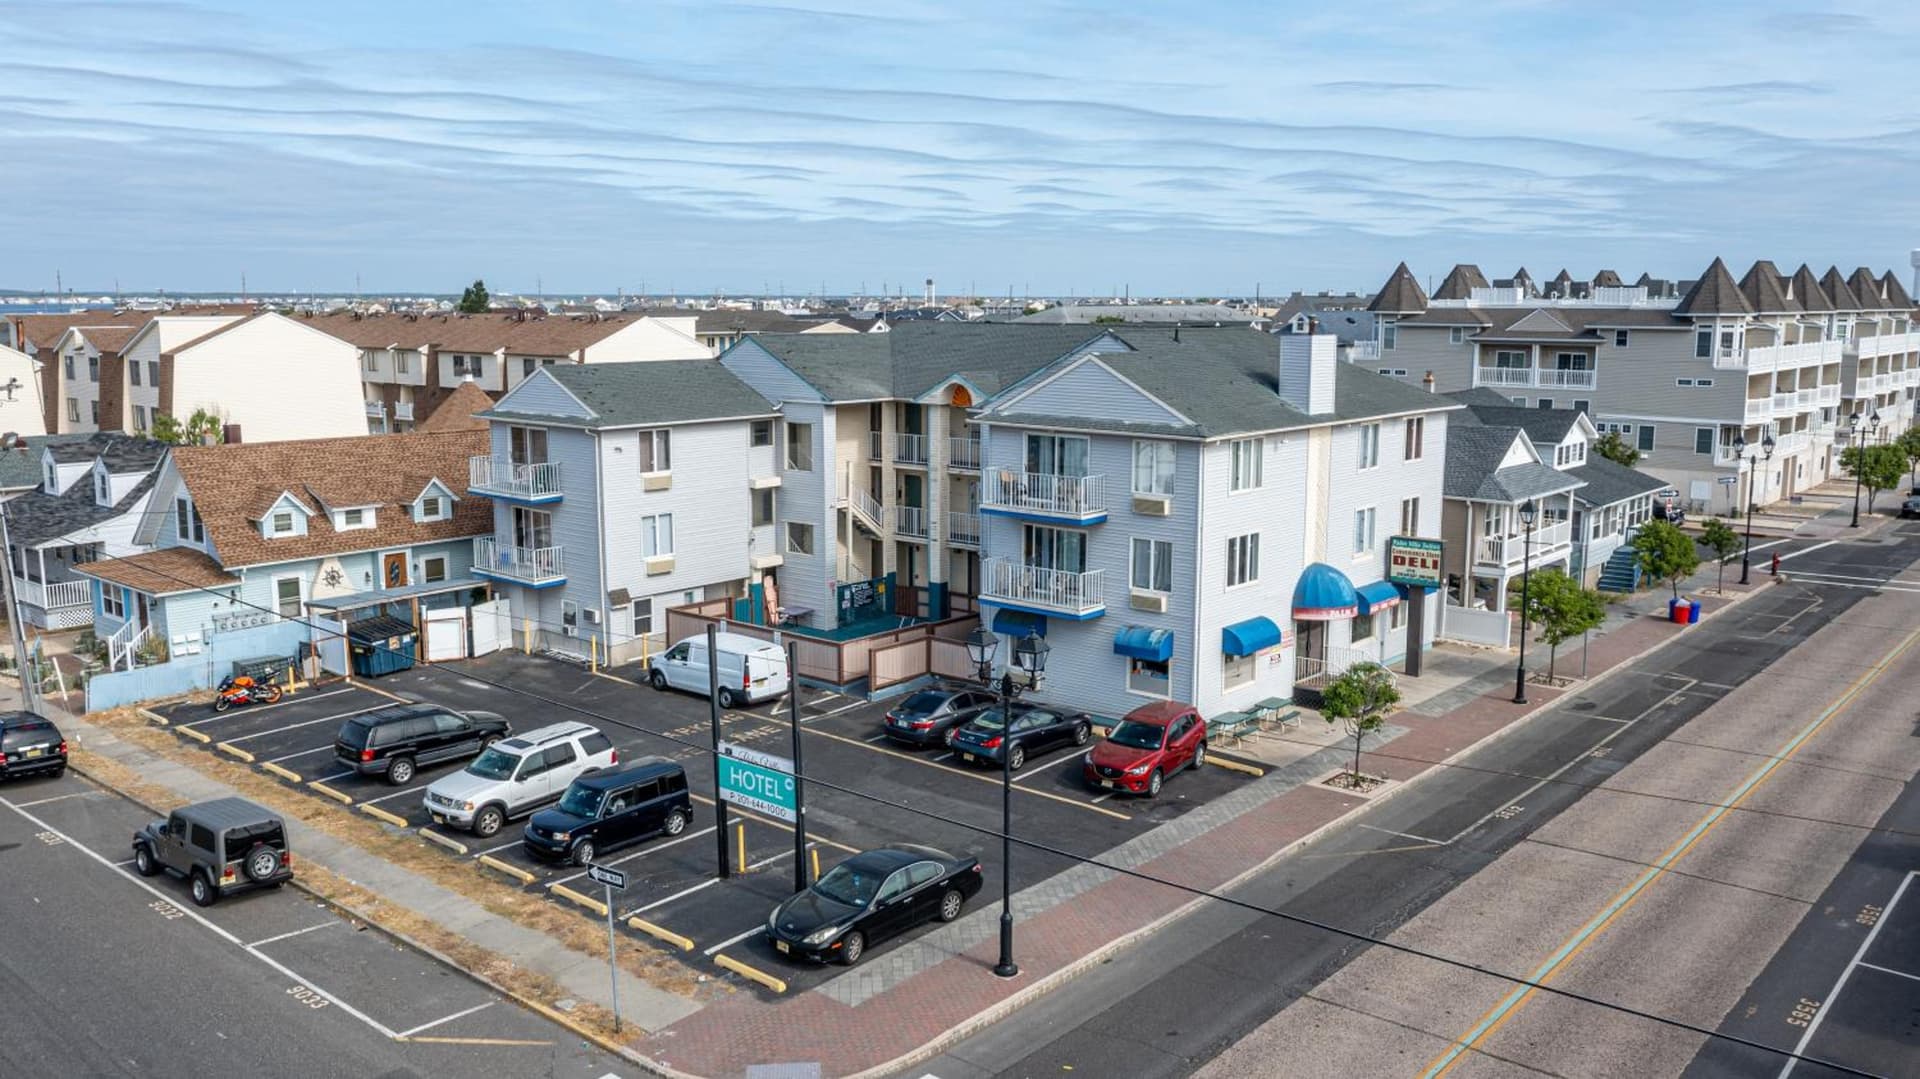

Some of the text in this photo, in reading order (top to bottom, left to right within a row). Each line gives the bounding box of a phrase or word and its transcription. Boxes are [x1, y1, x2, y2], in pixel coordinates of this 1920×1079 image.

[1393, 555, 1439, 570] DELI
[730, 766, 783, 800] HOTEL
[286, 985, 329, 1008] 9033
